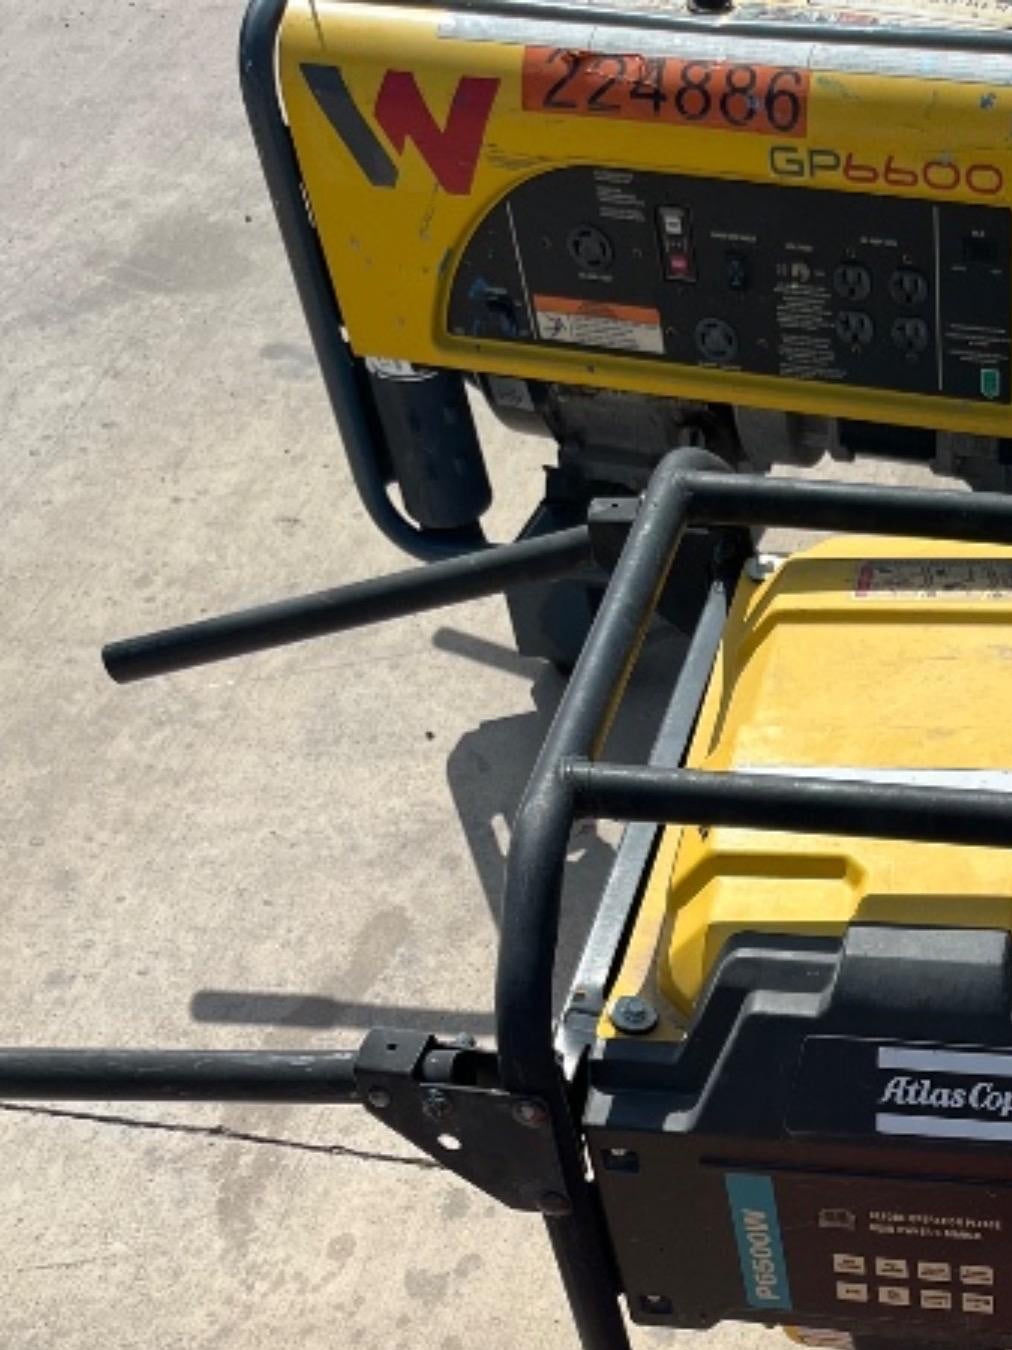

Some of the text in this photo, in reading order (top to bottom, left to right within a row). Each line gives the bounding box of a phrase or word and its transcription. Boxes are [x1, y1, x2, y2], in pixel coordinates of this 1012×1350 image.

[542, 47, 802, 132] 224886
[769, 145, 1004, 193] GP6600
[880, 1075, 967, 1108] Atlas
[740, 1207, 781, 1301] P6500W
